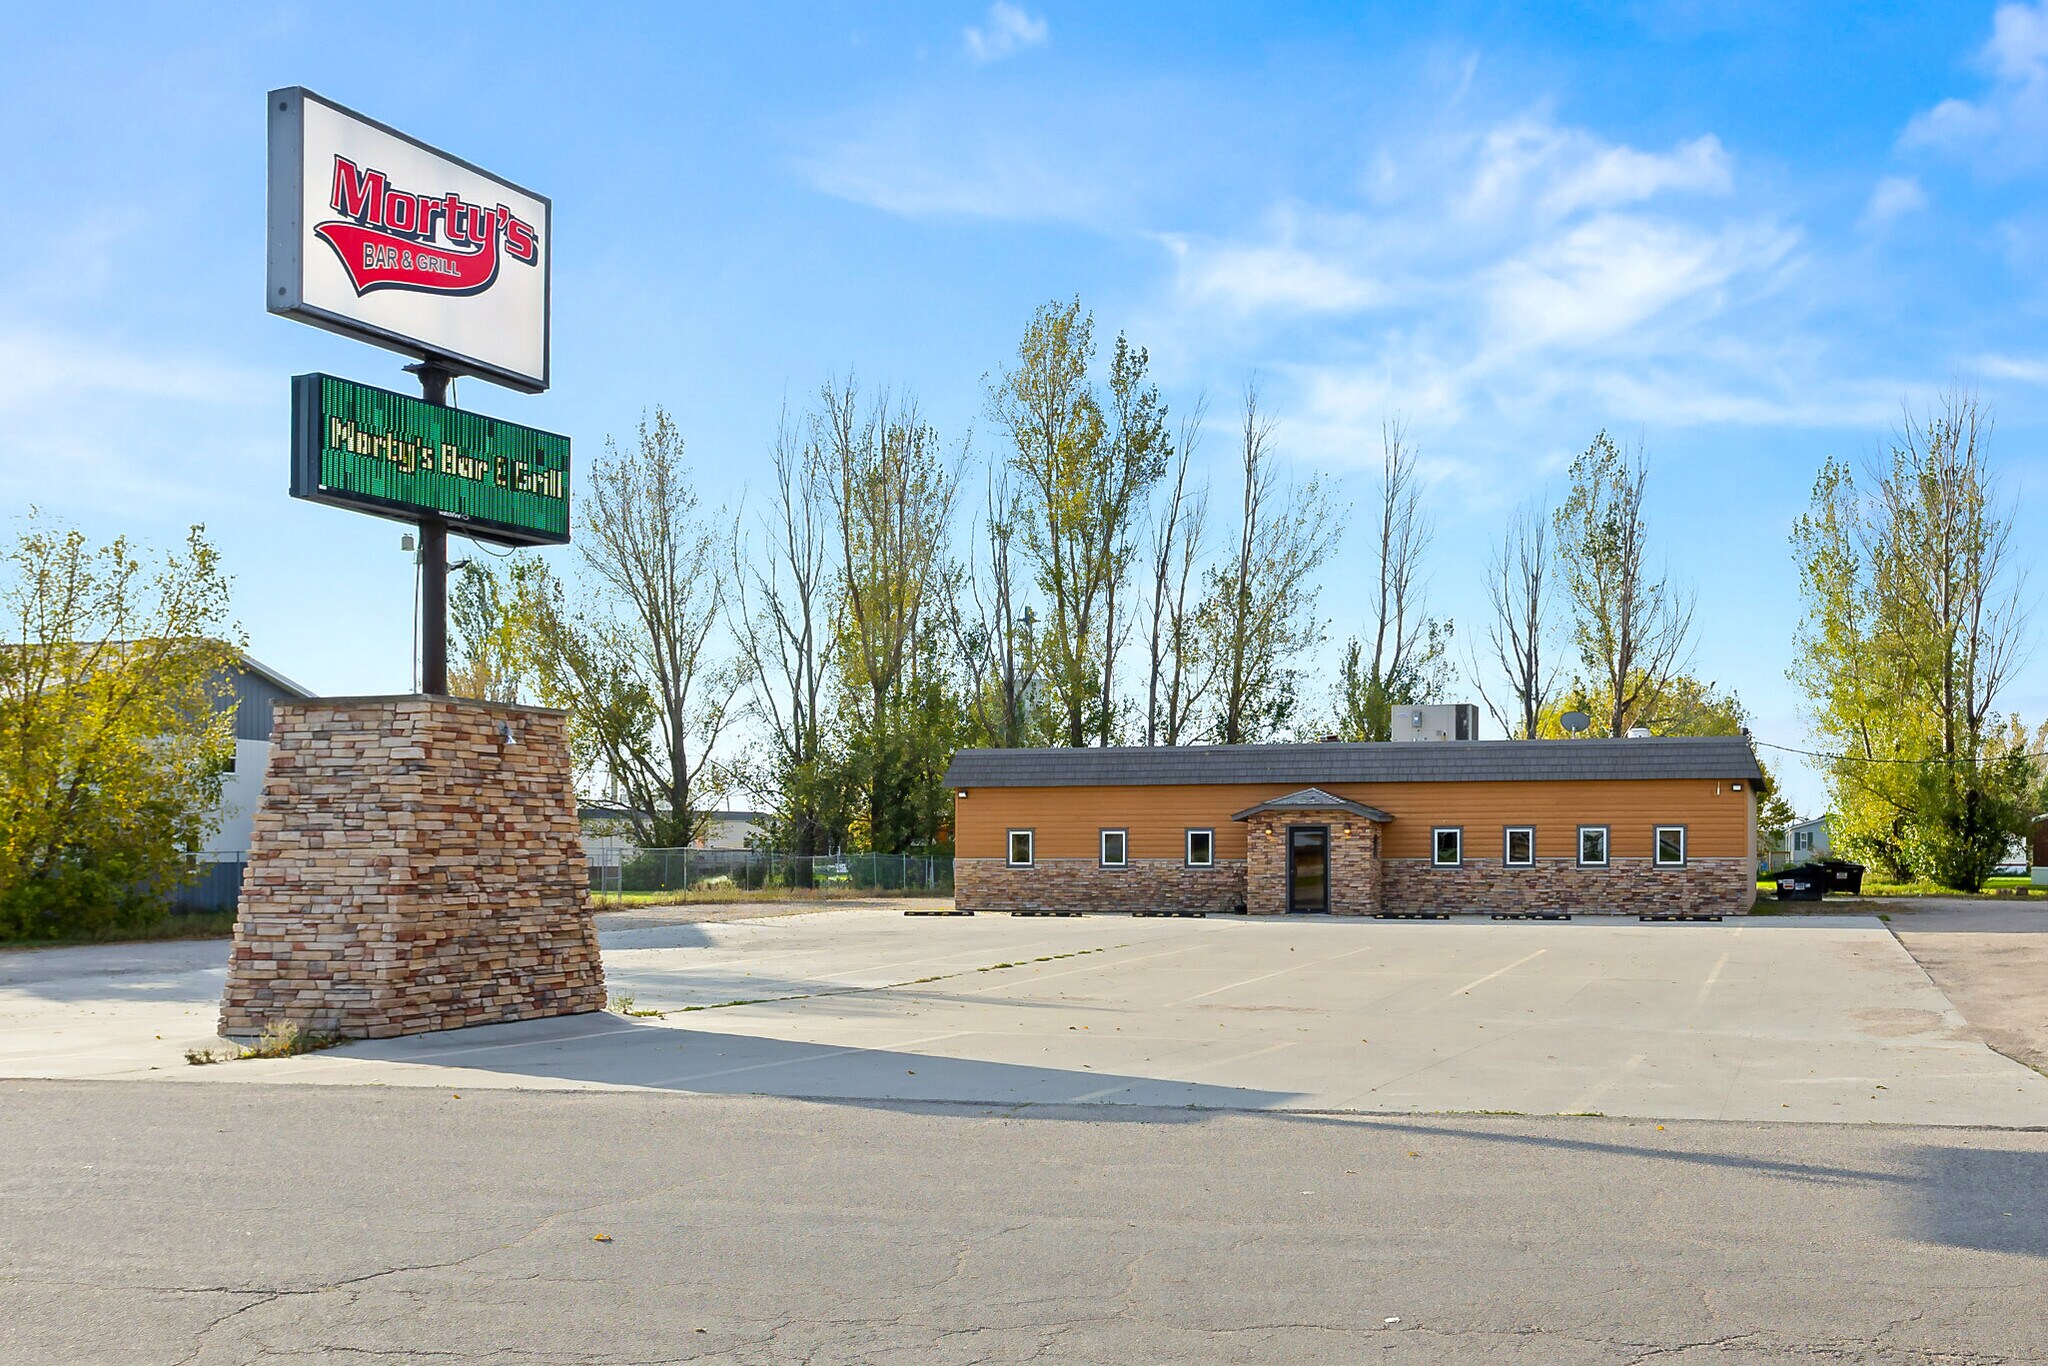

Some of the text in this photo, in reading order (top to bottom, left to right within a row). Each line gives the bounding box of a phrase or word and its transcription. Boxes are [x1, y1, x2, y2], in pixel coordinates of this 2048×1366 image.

[330, 154, 540, 267] Morty's
[363, 243, 461, 276] BAR & GRILL
[331, 416, 433, 473] Morty's
[442, 443, 488, 481] Bar
[515, 460, 562, 498] Grill
